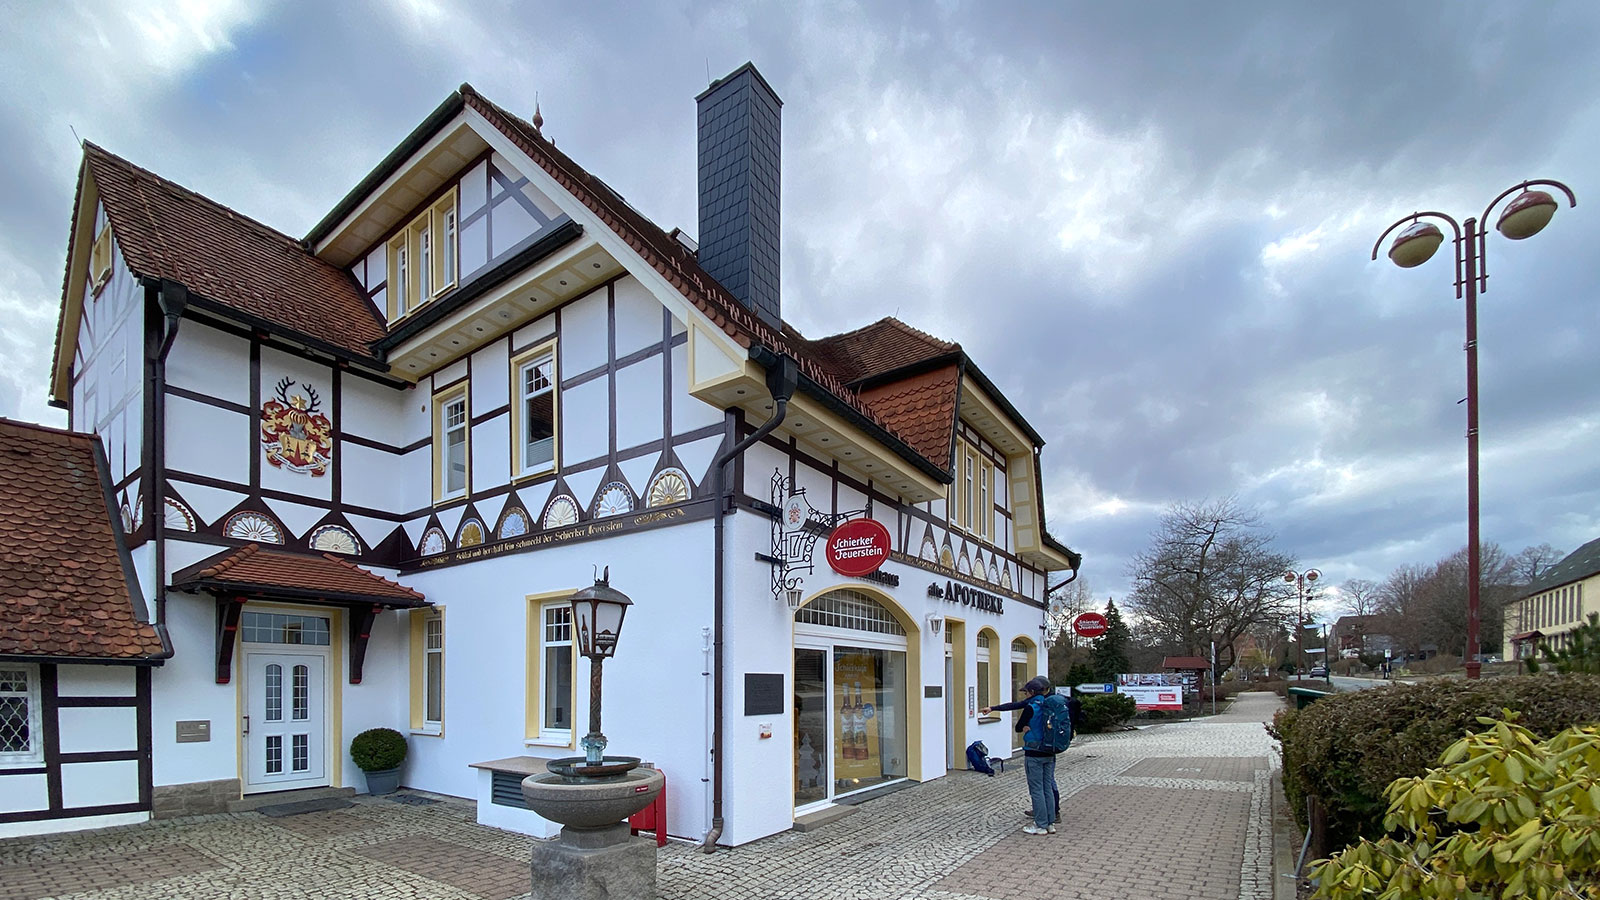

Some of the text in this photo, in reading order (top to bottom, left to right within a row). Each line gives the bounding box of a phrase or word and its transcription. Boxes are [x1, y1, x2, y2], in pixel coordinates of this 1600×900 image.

[555, 528, 585, 541] Schierker
[832, 536, 874, 549] Schierker
[835, 545, 883, 560] Feuerstein
[927, 582, 944, 599] alte
[944, 580, 1004, 615] APOTHEKE
